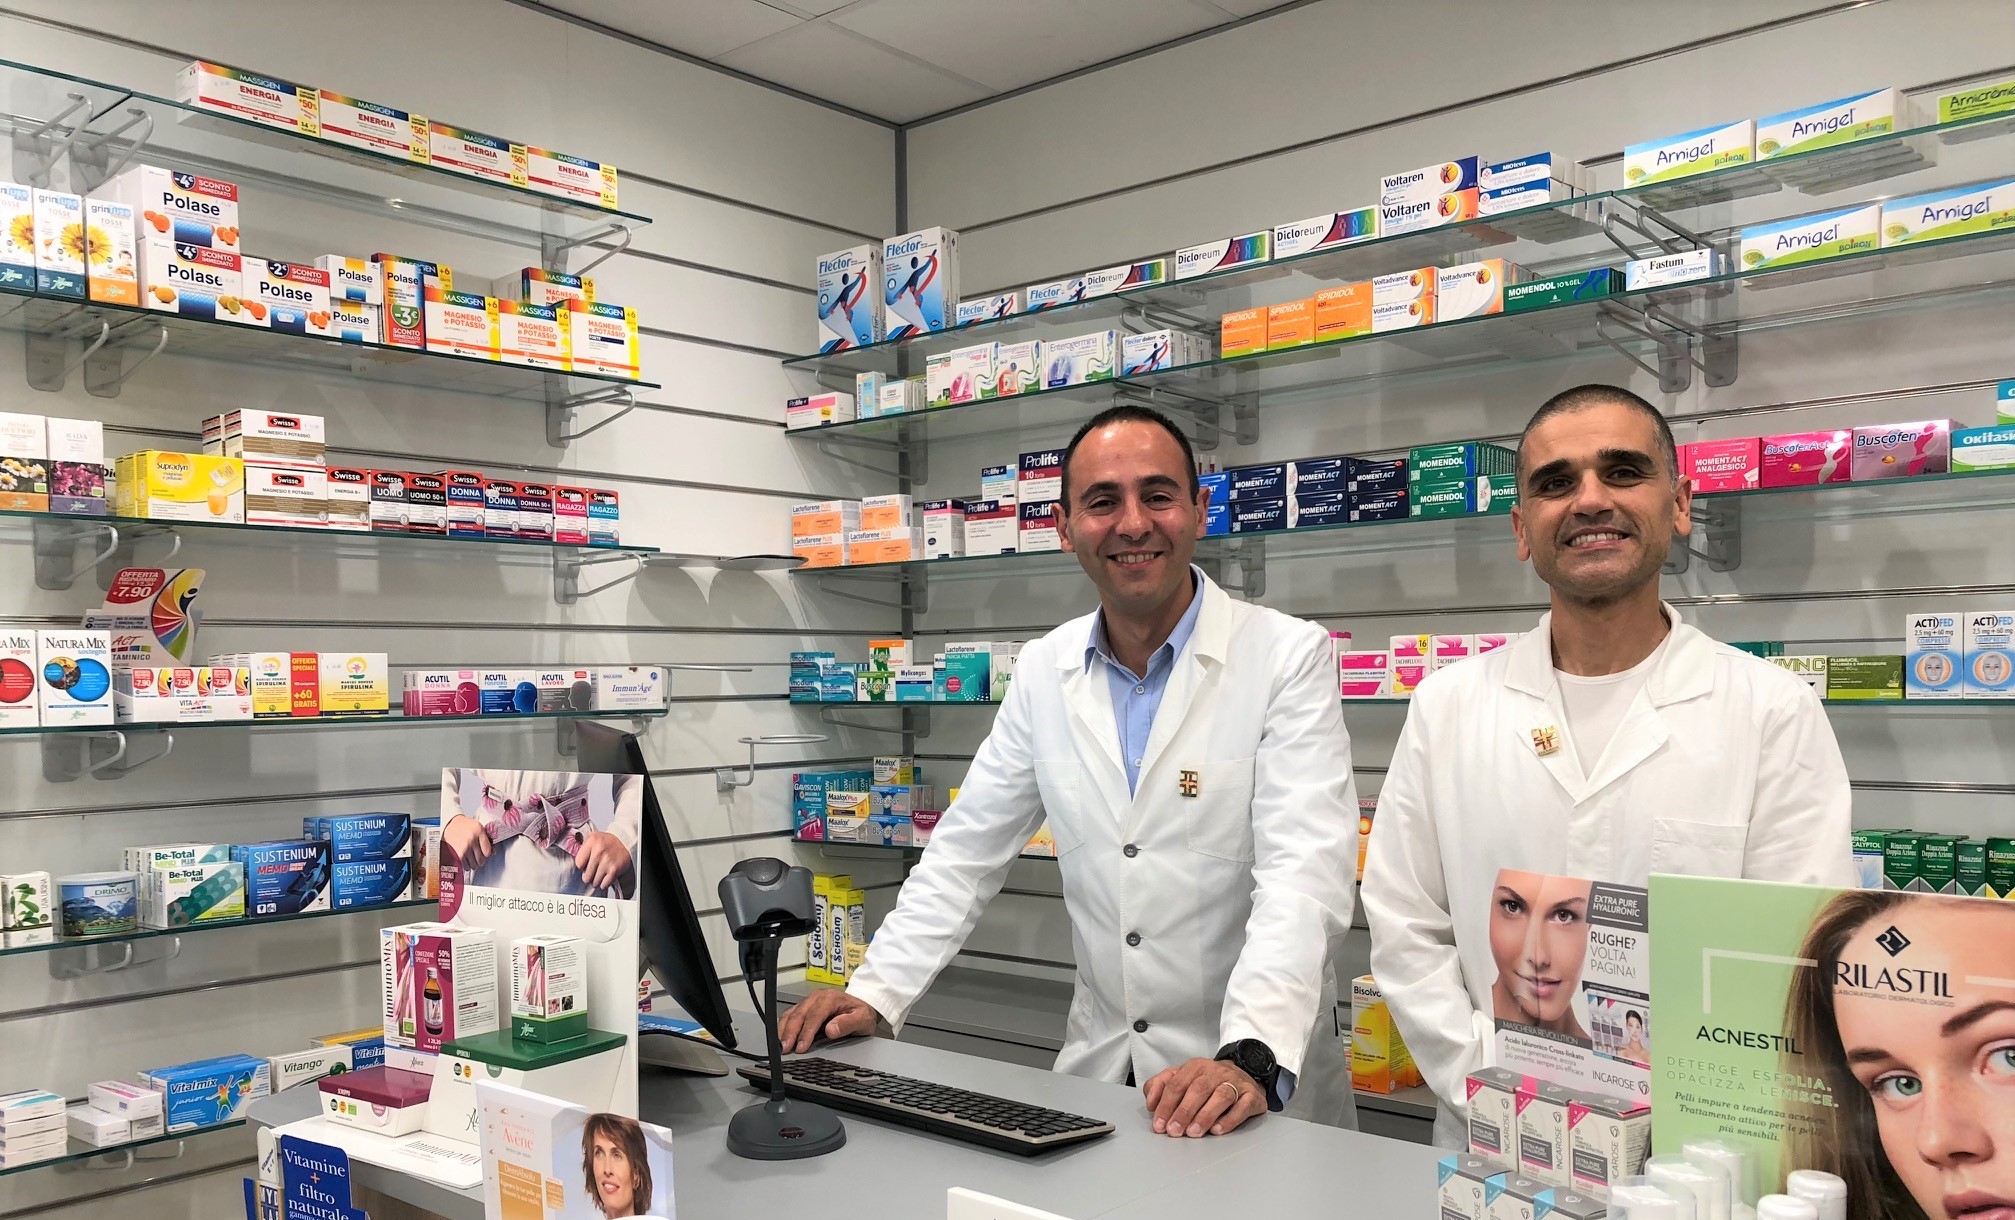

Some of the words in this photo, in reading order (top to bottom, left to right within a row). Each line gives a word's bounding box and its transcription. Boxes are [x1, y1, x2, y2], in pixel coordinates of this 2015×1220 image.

[240, 85, 282, 104] ENERGIA
[358, 112, 396, 130] ENERGIA
[1792, 108, 1853, 138] Arnigel
[1657, 139, 1713, 165] Arnigel
[198, 180, 232, 192] SCONTO
[1384, 172, 1424, 188] Voltaren
[199, 187, 232, 199] IMMEDIATO
[163, 191, 221, 216] Polase
[1382, 200, 1430, 219] Voltaren
[101, 218, 122, 228] TOSSE
[1278, 224, 1323, 242] Dicloreum
[886, 241, 921, 258] Flector
[1839, 239, 1871, 254] BOIRON
[202, 252, 234, 262] SCONTO
[1178, 248, 1220, 264] Dicloreum
[820, 257, 851, 274] Flector
[1650, 258, 1684, 271] Fastum
[291, 268, 322, 280] SCONTO
[338, 268, 373, 283] Polase
[1374, 274, 1408, 286] Voltadvance
[1440, 270, 1476, 282] Voltadvance
[260, 282, 312, 302] Polase
[1318, 288, 1355, 302] SPIDIDOL
[443, 292, 484, 307] MASSIGEN
[516, 305, 556, 318] MASSIGEN
[1270, 302, 1305, 315] SPIDIDOL
[444, 310, 482, 322] MAGNESIO
[450, 319, 486, 331] POTASSIO
[518, 322, 554, 333] MAGNESIO
[1050, 337, 1097, 353] Enterogermina
[1857, 430, 1917, 448] Buscofen
[156, 461, 188, 472] Supradyn
[1025, 454, 1058, 468] Prolife
[1419, 457, 1464, 468] MOMENDOL
[1696, 462, 1746, 474] ANALGESICO
[334, 472, 361, 482] Swisse
[453, 474, 478, 484] Swisse
[1026, 470, 1034, 480] 10
[415, 477, 440, 488] Swisse
[376, 488, 403, 498] UOMO
[410, 492, 430, 500] UOMO
[432, 492, 444, 500] 50+
[450, 487, 480, 497] DONNA
[1420, 492, 1464, 504] MOMENDOL
[488, 496, 516, 506] DONNA
[520, 500, 540, 508] DONNA
[556, 502, 586, 512] RAGAZZA
[589, 505, 618, 515] RAGAZZO
[792, 504, 820, 513] Lactoflorene
[968, 504, 988, 513] Prolife
[1419, 640, 1427, 648] 16
[424, 675, 450, 684] ACUTIL
[484, 674, 507, 682] ACUTIL
[860, 681, 891, 692] Buscopan
[294, 690, 312, 698] +60
[294, 700, 318, 708] GRATIS
[875, 758, 896, 767] Maalox
[794, 783, 822, 792] GAVISCON
[828, 794, 848, 802] Maalox
[336, 819, 386, 832] SUSTENIUM
[828, 818, 849, 827] Maalox
[339, 832, 362, 840] MEMO
[1890, 842, 1912, 850] Rinazina
[1926, 844, 1948, 852] Rinazina
[155, 850, 195, 861] Be-Total
[254, 847, 317, 864] SUSTENIUM
[1922, 850, 1937, 858] Doppia
[169, 868, 204, 879] Be-Total
[257, 864, 288, 875] MEMO
[336, 864, 386, 877] SUSTENIUM
[339, 876, 364, 886] MEMO
[441, 882, 454, 892] 50%
[94, 886, 128, 896] DRIMO
[476, 894, 506, 911] miglior
[508, 897, 544, 913] attacco
[548, 899, 554, 914] è
[556, 900, 564, 914] la
[568, 898, 607, 919] difesa
[1594, 894, 1618, 906] EXTRA
[1618, 898, 1638, 909] PURE
[1593, 903, 1640, 918] HYALURONIC
[1591, 931, 1636, 951] RUGHE?
[438, 950, 450, 958] 50%
[1590, 946, 1628, 963] VOLTA
[1591, 961, 1636, 979] PAGINA!
[1834, 960, 1955, 998] RILASTIL
[1502, 1022, 1537, 1037] MASCHERA
[1537, 1029, 1578, 1046] REVOLUTION
[1696, 1025, 1804, 1056] ACNESTIL
[1504, 1036, 1520, 1046] Acido
[1548, 1045, 1585, 1062] Cross-linkato
[284, 1060, 322, 1074] Vitango
[170, 1078, 219, 1095] Vitalmix
[1592, 1070, 1635, 1092] INCAROSE
[1760, 1086, 1840, 1108] LENISCE.
[171, 1096, 204, 1111] junior
[1674, 1091, 1696, 1103] Pelli
[1698, 1096, 1731, 1112] impure
[1743, 1104, 1786, 1118] tendenza
[1679, 1104, 1736, 1123] Trattamento
[1738, 1116, 1767, 1128] attivo
[1769, 1122, 1784, 1133] per
[1788, 1124, 1797, 1132] le
[1718, 1124, 1734, 1137] più
[1737, 1128, 1781, 1142] sensibili.
[283, 1148, 346, 1178] Vitamine
[310, 1172, 320, 1184] +
[300, 1183, 335, 1205] filtro
[288, 1198, 350, 1220] naturale
